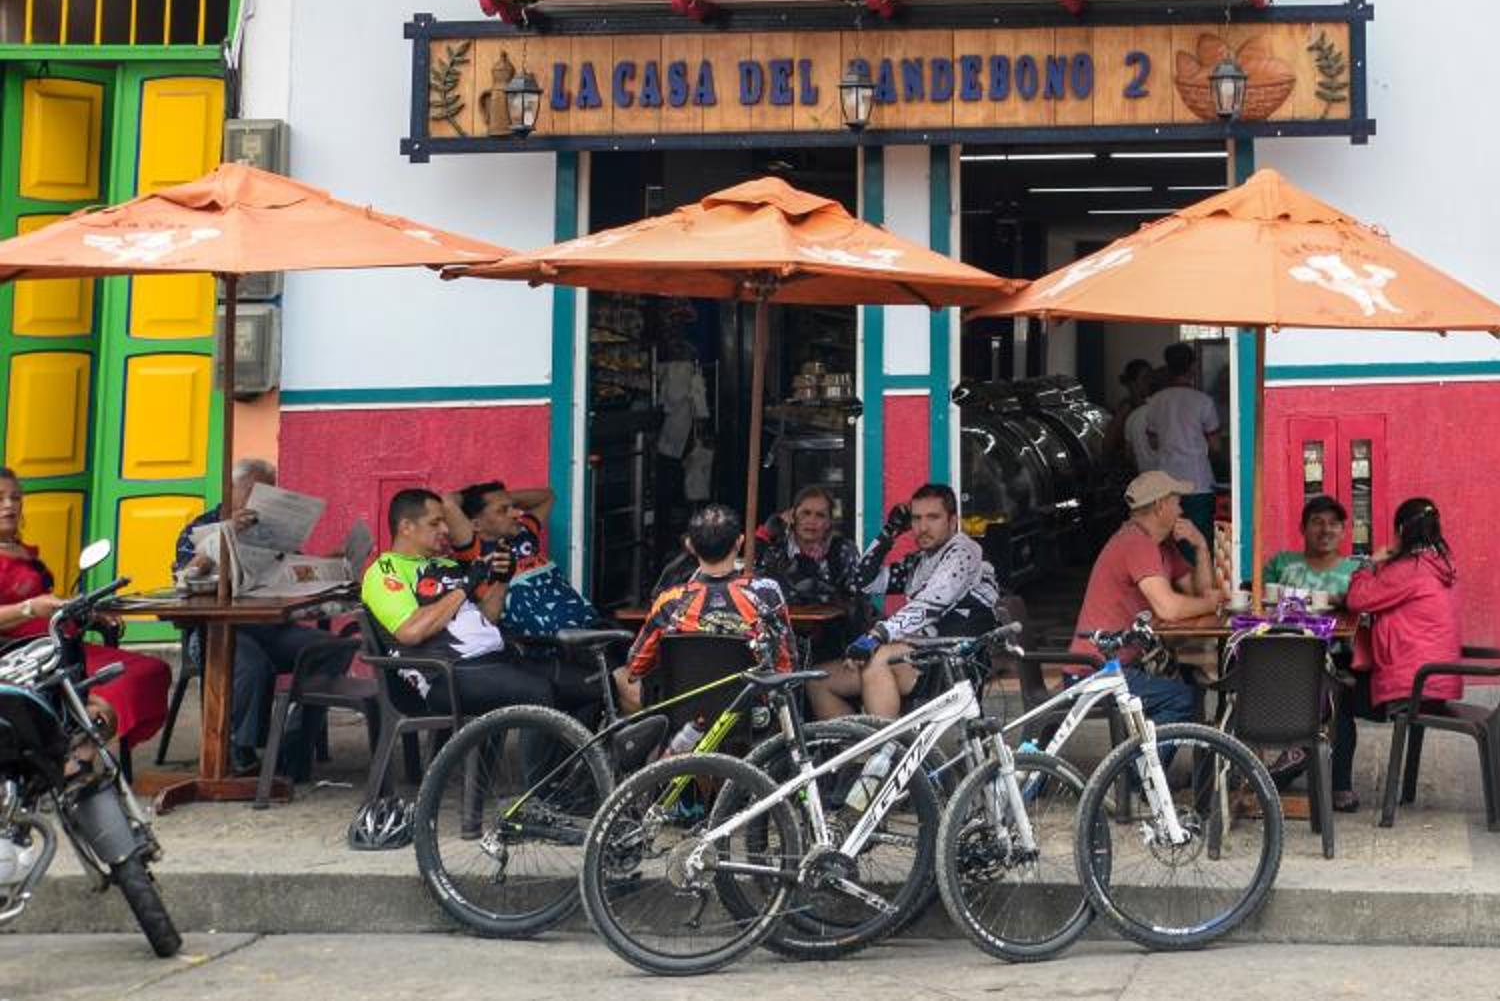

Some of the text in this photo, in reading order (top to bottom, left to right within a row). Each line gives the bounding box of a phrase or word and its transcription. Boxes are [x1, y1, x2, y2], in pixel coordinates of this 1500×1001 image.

[550, 61, 602, 111] LA
[612, 59, 717, 109] CASA
[738, 58, 819, 107] DEL
[1122, 51, 1151, 100] 2
